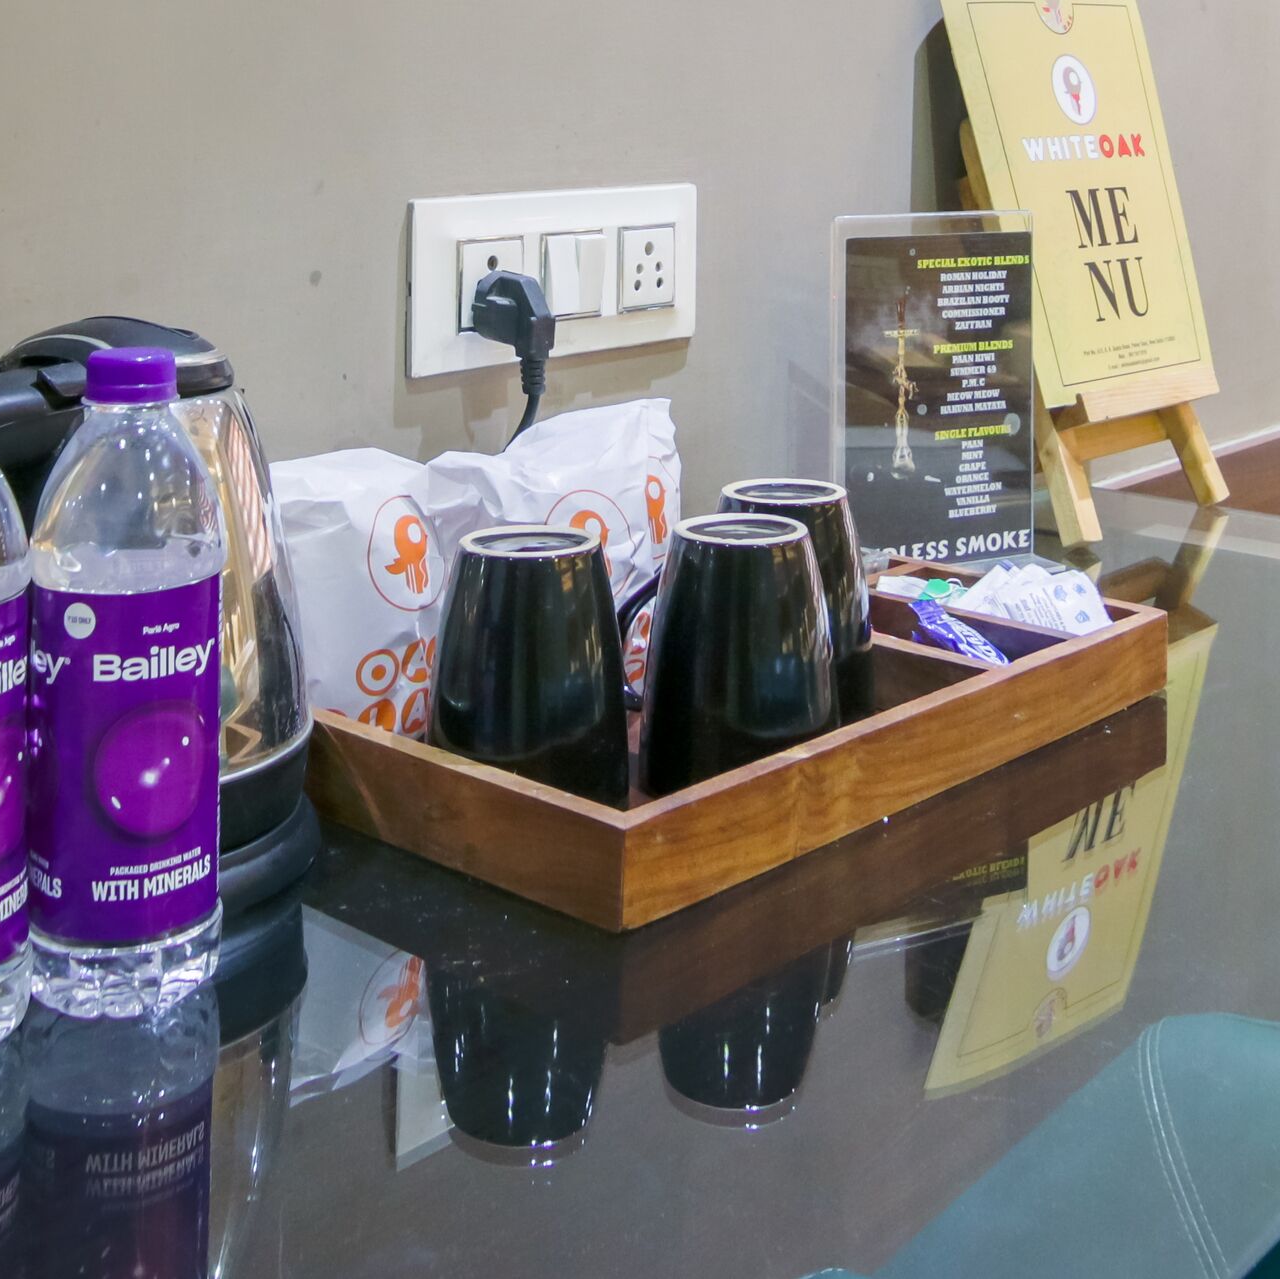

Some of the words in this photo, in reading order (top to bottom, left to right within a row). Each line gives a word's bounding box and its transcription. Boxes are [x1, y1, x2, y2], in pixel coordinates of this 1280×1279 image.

[1065, 186, 1139, 249] ME
[917, 257, 956, 269] SPECIAL
[957, 256, 992, 268] EXOTIC
[994, 255, 1029, 266] BLENDS
[940, 271, 971, 282] ROMAN
[971, 270, 1007, 281] HOLIDAY
[975, 282, 1005, 293] NIGHTS
[1084, 256, 1149, 323] NU
[937, 296, 981, 307] BRAZILIAN
[982, 294, 1010, 304] BOOTY
[942, 307, 1005, 319] COMMISSIONER
[933, 342, 977, 354] PREMIUM
[978, 340, 1013, 352] BLENDS
[952, 354, 974, 364] PAAN
[975, 353, 995, 362] KIWI
[950, 366, 986, 377] SUMMER
[987, 364, 997, 374] 69
[947, 391, 973, 402] MEOW
[974, 389, 1000, 399] MEOW
[940, 403, 974, 415] HAKUNA
[975, 401, 1007, 411] MATATA
[934, 428, 967, 440] SINGLE
[968, 424, 1012, 437] FLAVOURS
[961, 440, 983, 449] PAAN
[961, 450, 983, 460] MINT
[959, 462, 986, 472] GRAPE
[955, 472, 989, 483] ORANGE
[944, 482, 1002, 496] WATERMELON
[956, 495, 990, 506] VANILLA
[948, 504, 997, 518] BLUEBERRY
[955, 528, 1030, 556] SMOKE
[93, 637, 215, 682] Bailley
[110, 863, 148, 877] PACKAGED
[149, 856, 182, 873] DRINKING
[182, 846, 202, 863] WATER
[92, 879, 139, 903] WITH
[143, 854, 211, 899] MINERALS
